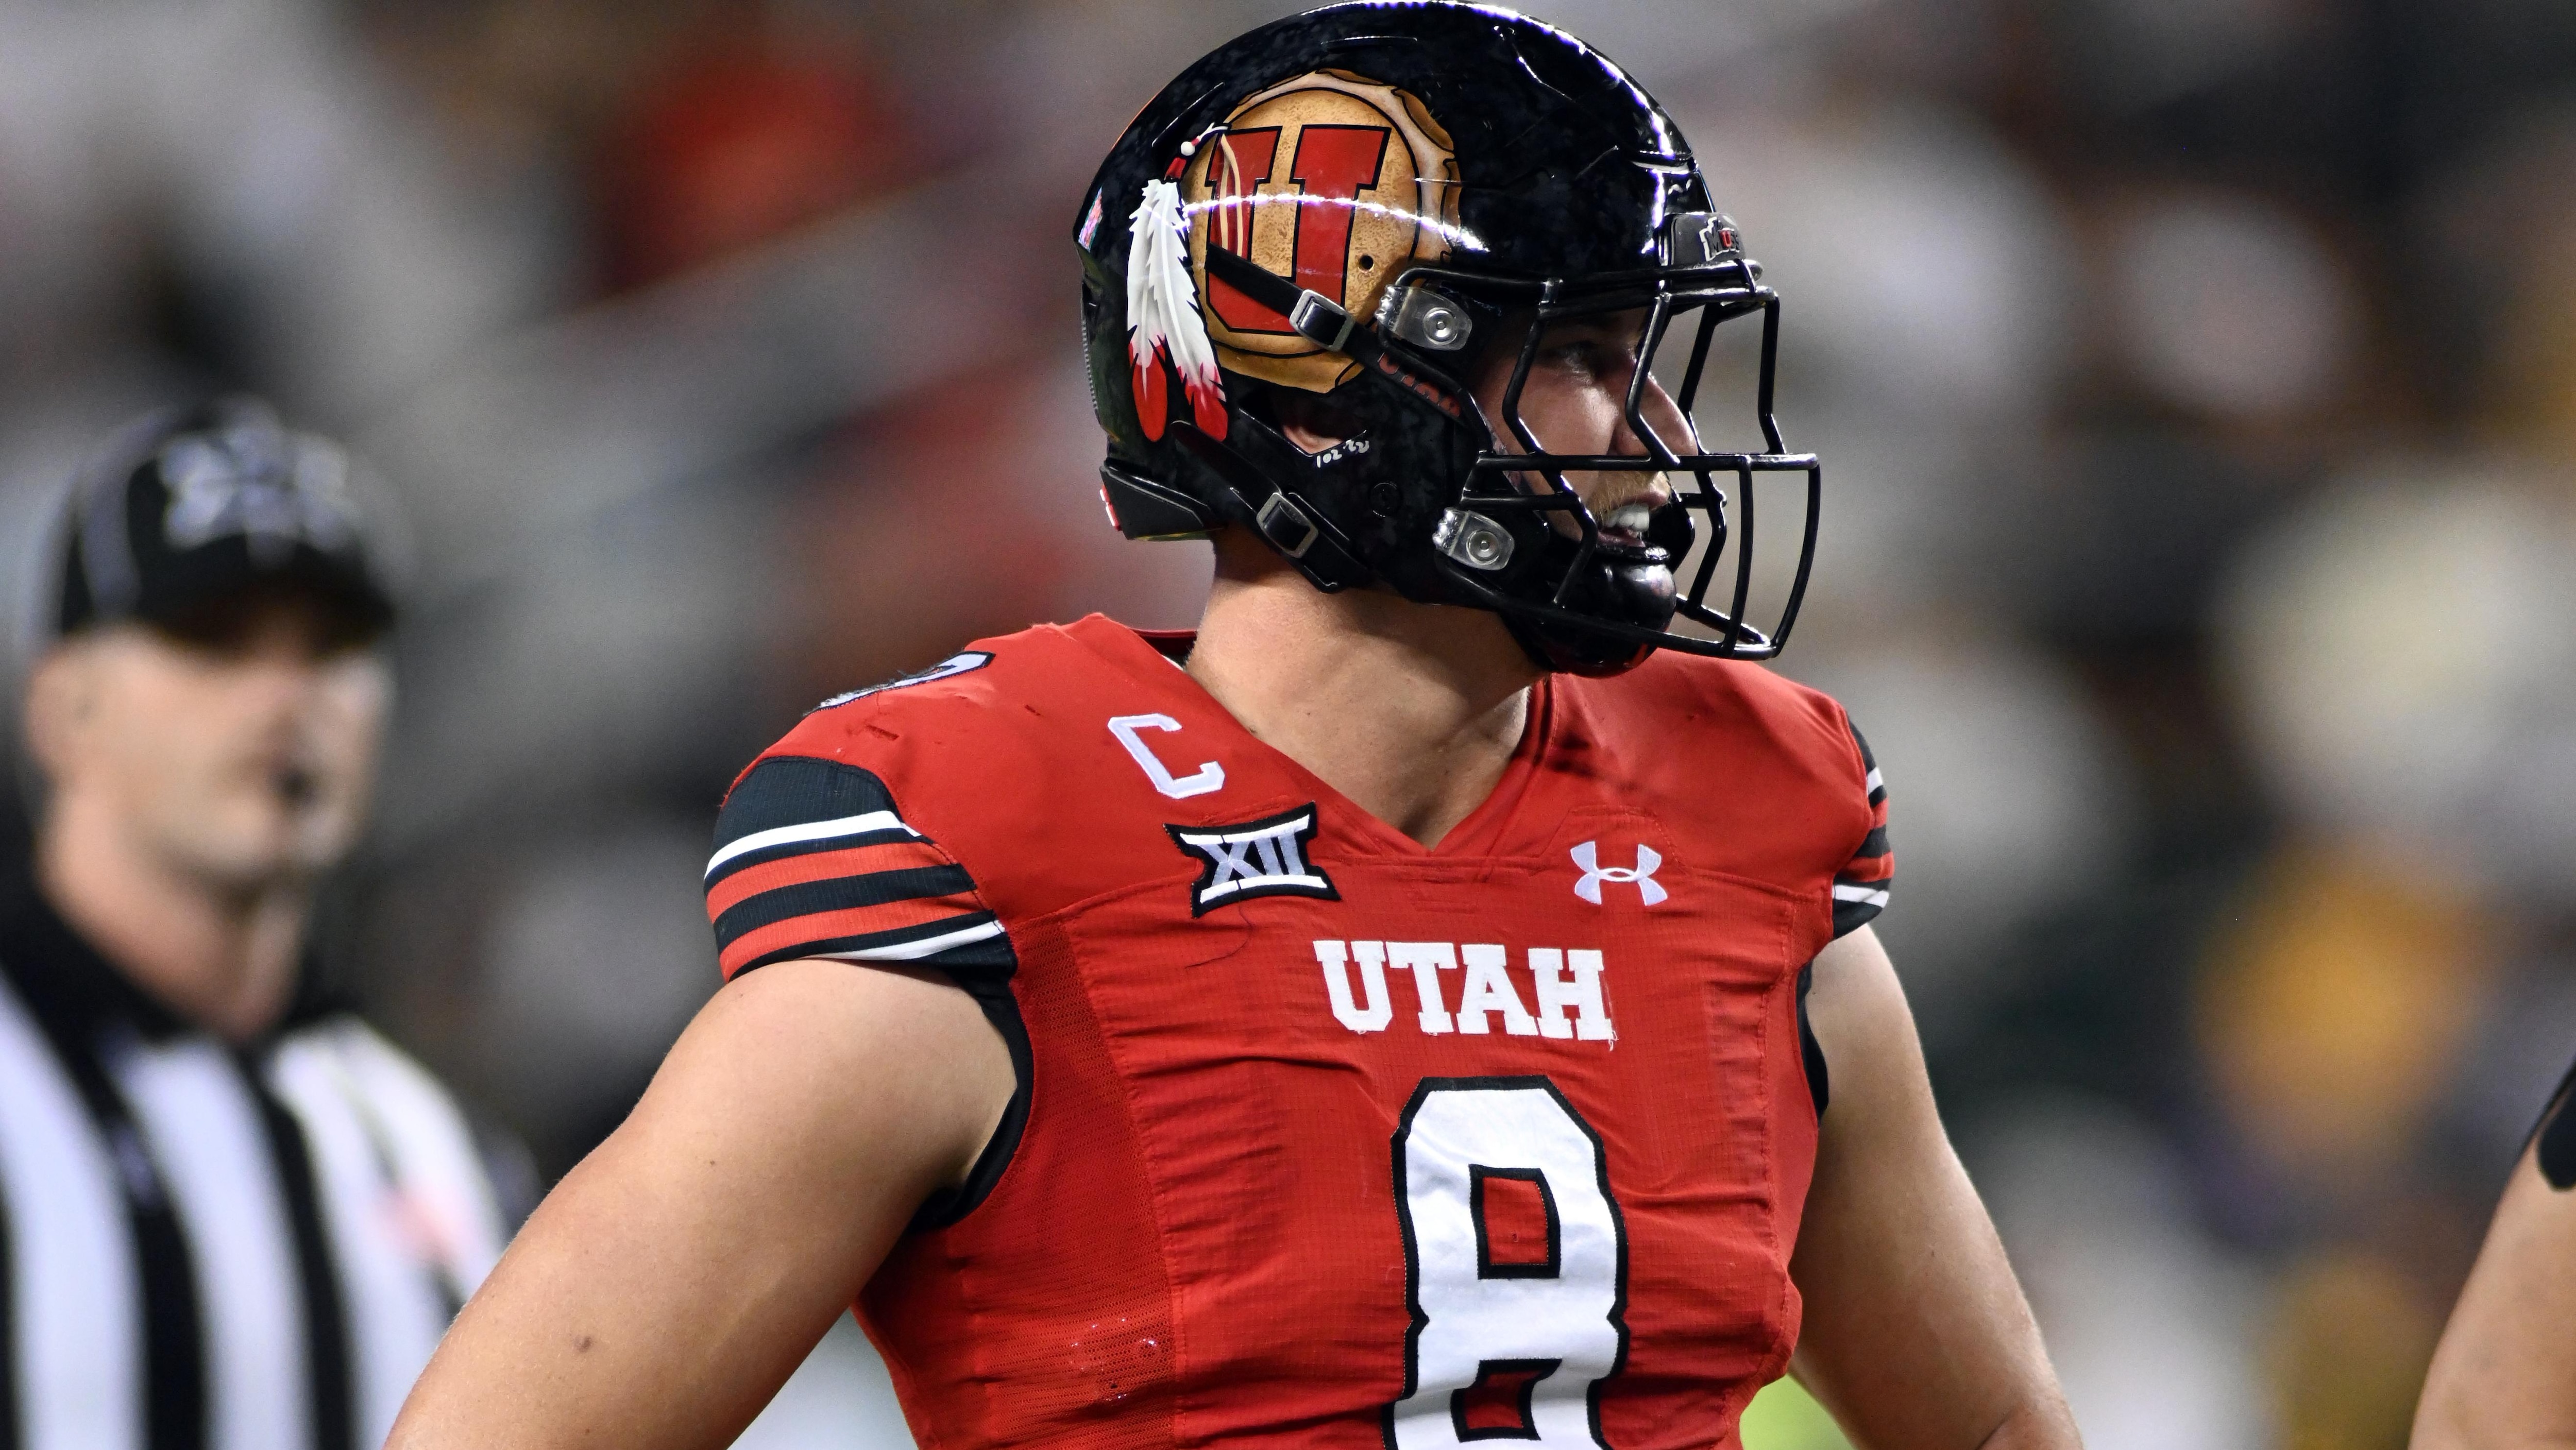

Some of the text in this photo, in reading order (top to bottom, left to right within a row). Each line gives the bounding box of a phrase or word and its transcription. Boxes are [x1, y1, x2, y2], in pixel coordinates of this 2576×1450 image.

[1206, 124, 1392, 337] U
[1108, 713, 1225, 799] C
[1180, 814, 1328, 905] XII
[1313, 939, 1615, 1041] UTAH
[1381, 1074, 1630, 1450] 8
